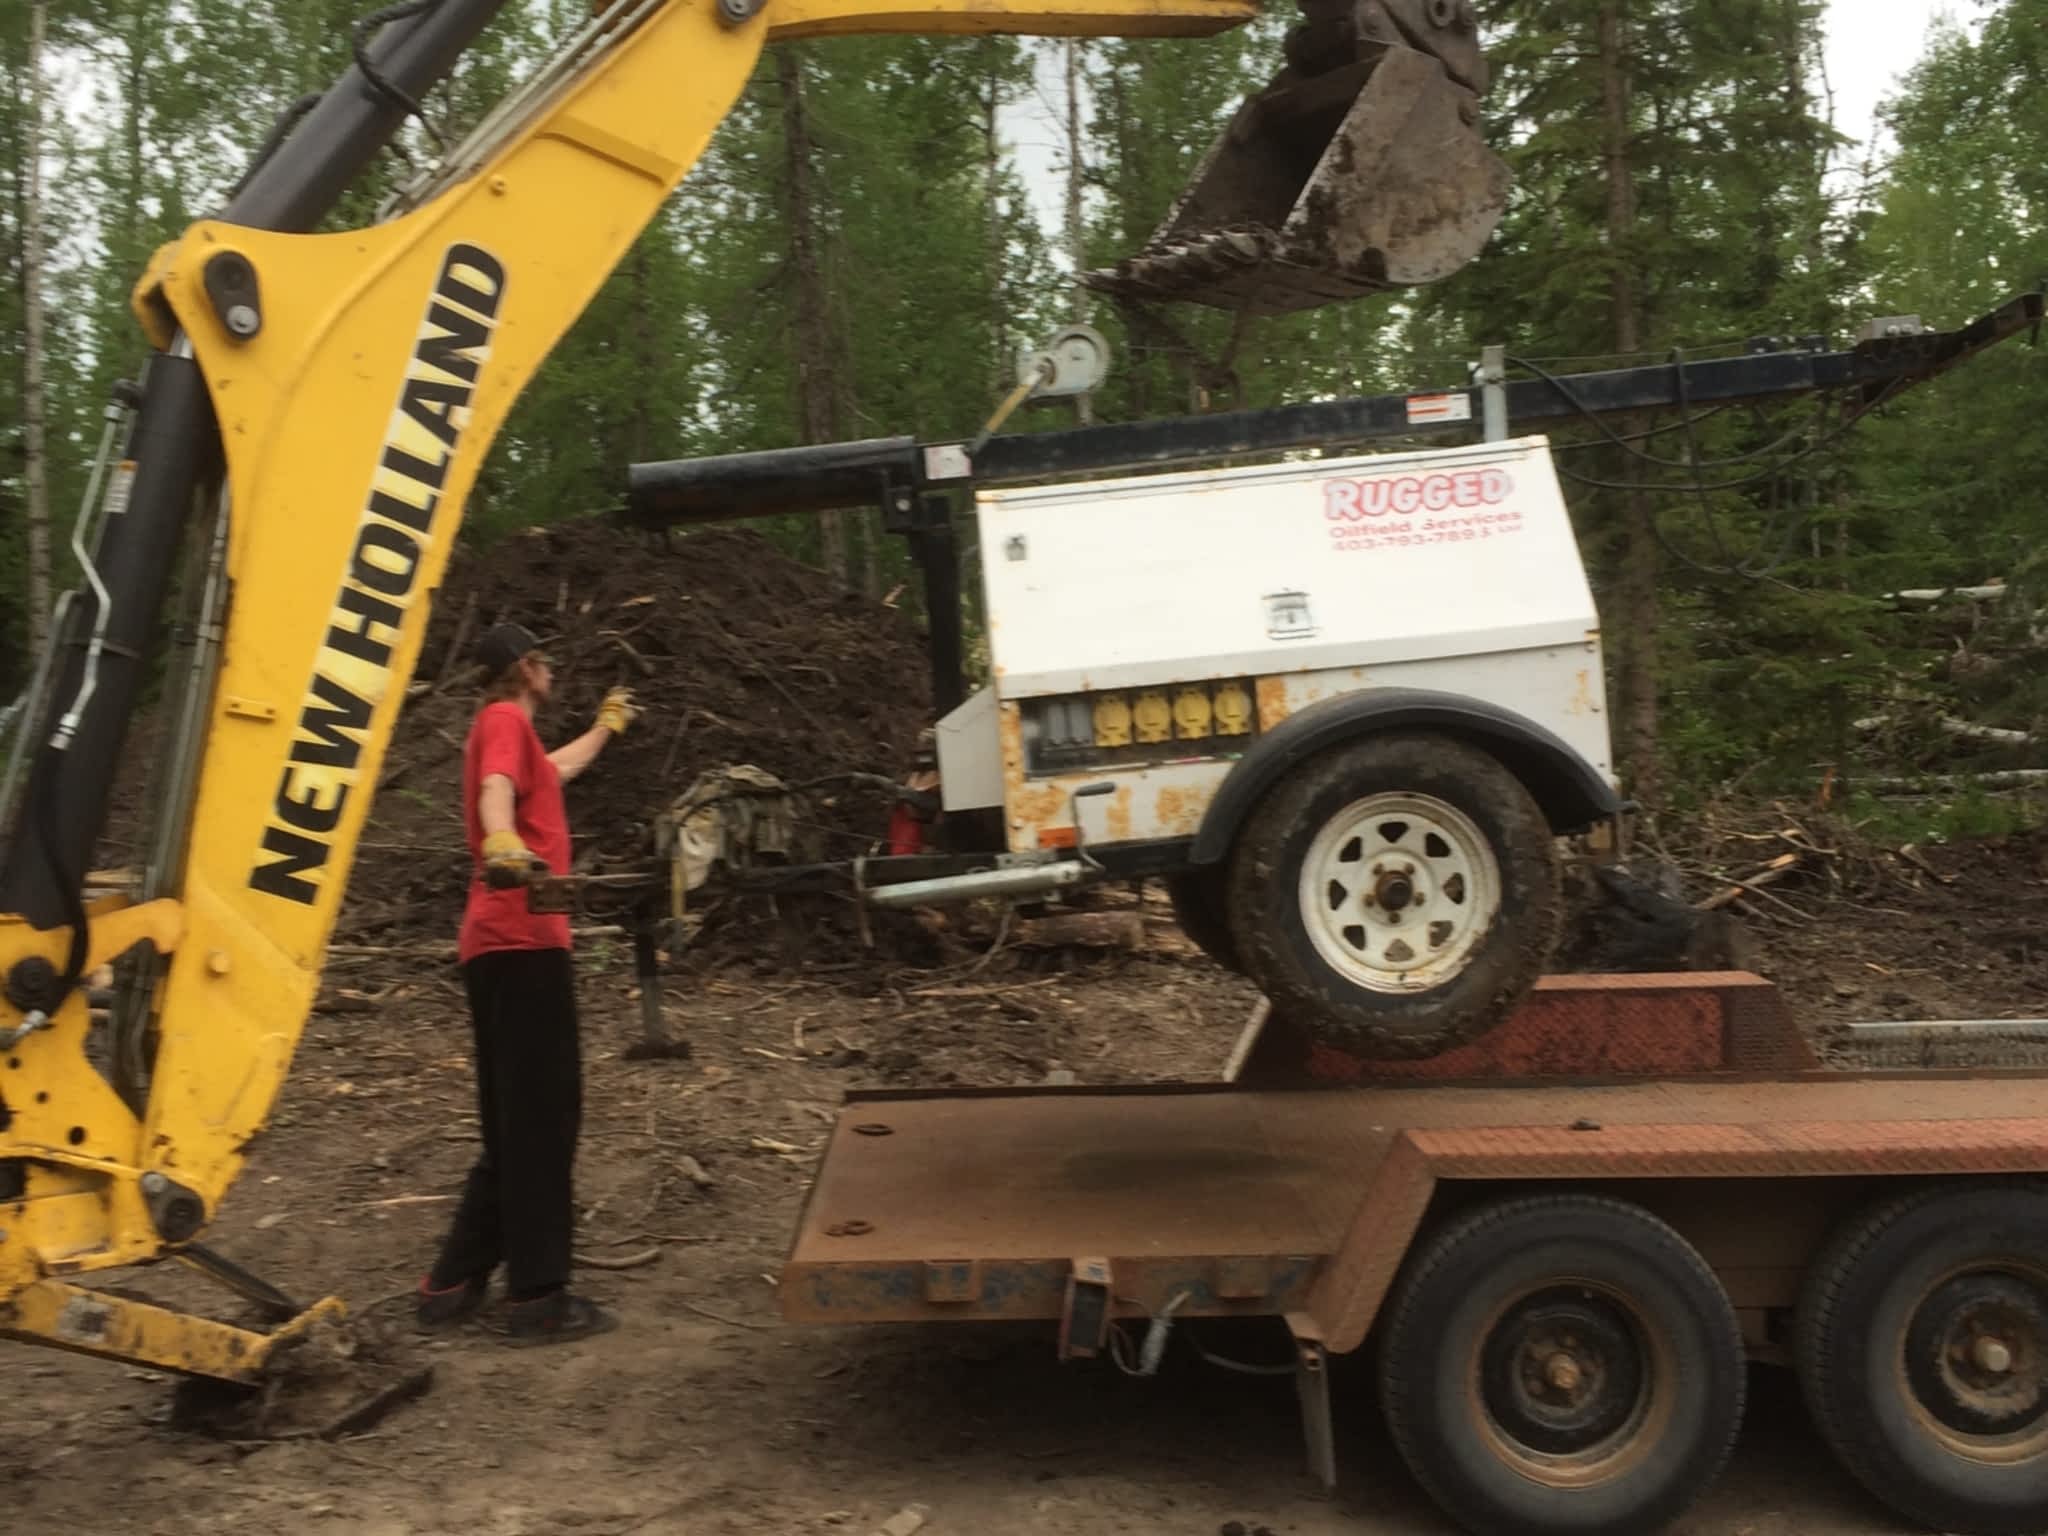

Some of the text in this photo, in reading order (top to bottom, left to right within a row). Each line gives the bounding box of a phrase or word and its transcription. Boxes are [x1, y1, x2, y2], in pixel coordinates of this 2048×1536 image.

[1324, 469, 1514, 521] RUGGED
[1422, 511, 1522, 531] Services
[249, 242, 506, 906] NEW HOLLAND
